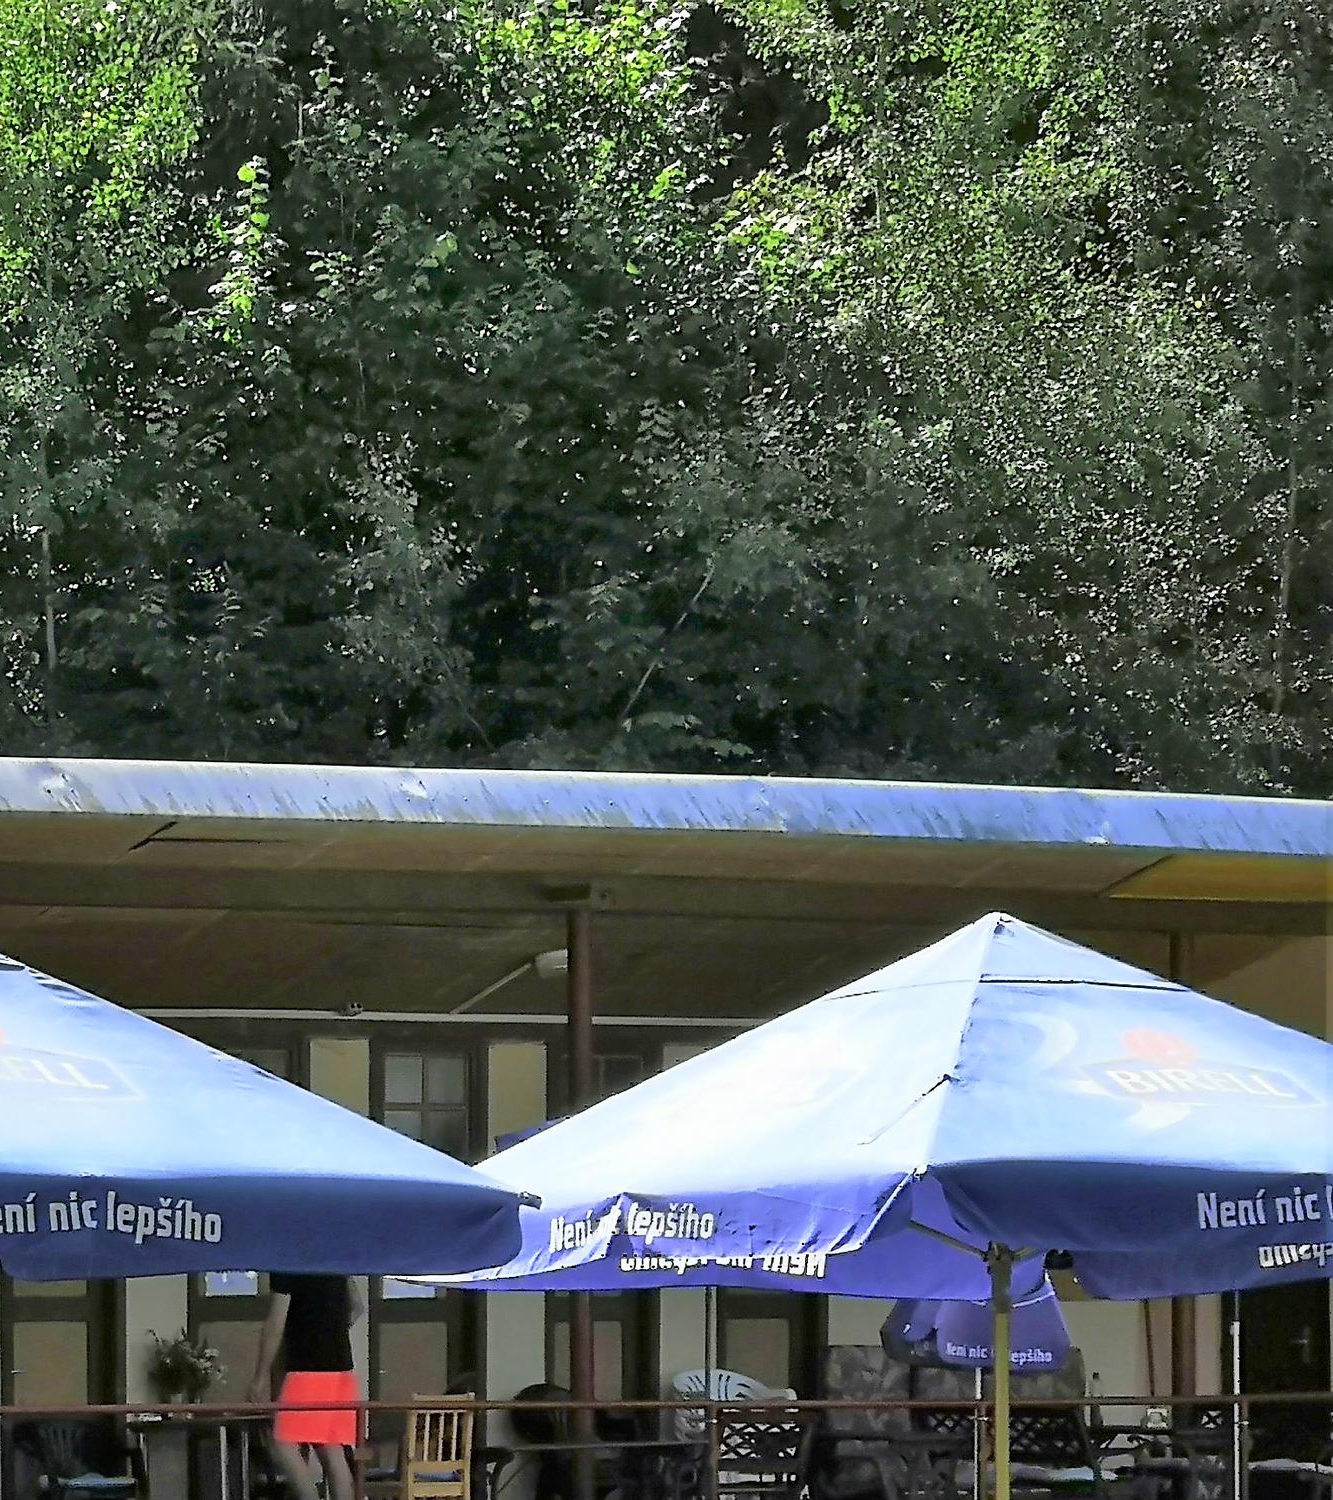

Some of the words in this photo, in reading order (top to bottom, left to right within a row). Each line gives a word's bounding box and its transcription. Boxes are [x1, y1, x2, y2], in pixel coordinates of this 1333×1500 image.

[1104, 1068, 1297, 1099] BIRELL
[49, 1190, 99, 1233] nic
[105, 1189, 224, 1245] lepšího
[626, 1201, 715, 1246] lepšího
[1196, 1187, 1267, 1230] Není
[1274, 1185, 1321, 1225] nic
[968, 1344, 989, 1359] nic
[1008, 1347, 1054, 1366] epšího
